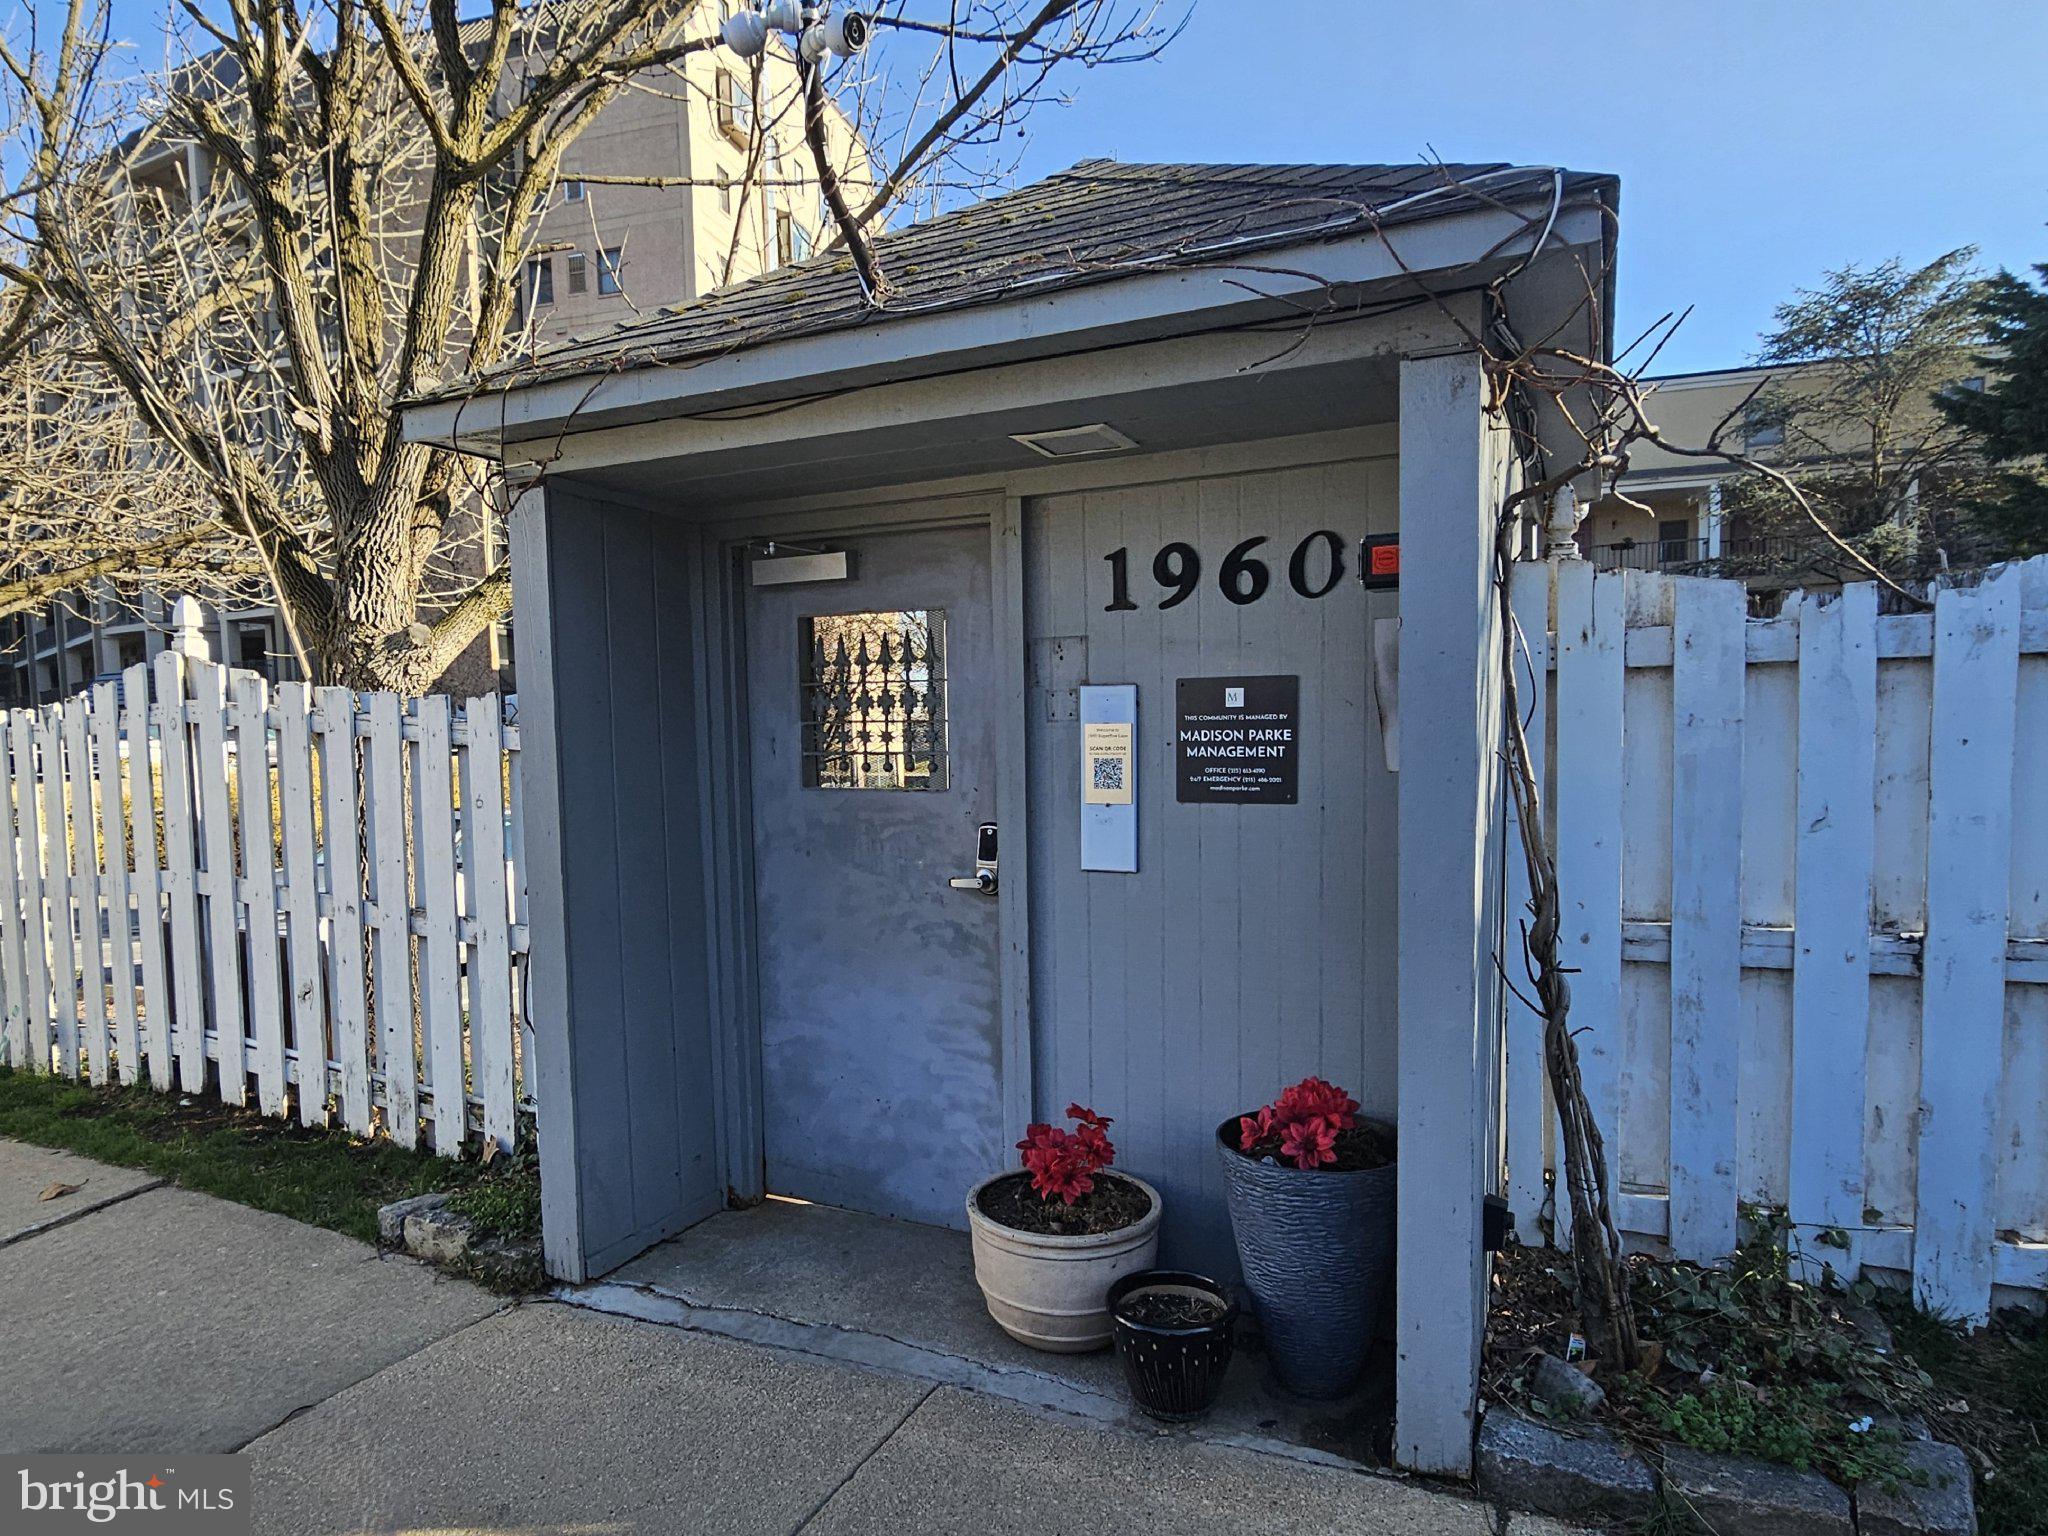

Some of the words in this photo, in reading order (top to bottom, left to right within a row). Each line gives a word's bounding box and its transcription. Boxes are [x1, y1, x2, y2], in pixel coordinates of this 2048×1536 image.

[1104, 530, 1345, 611] 1960
[1180, 729, 1244, 742] MADISON
[1248, 729, 1292, 741] PARKE
[1186, 745, 1286, 758] MANAGEMENT
